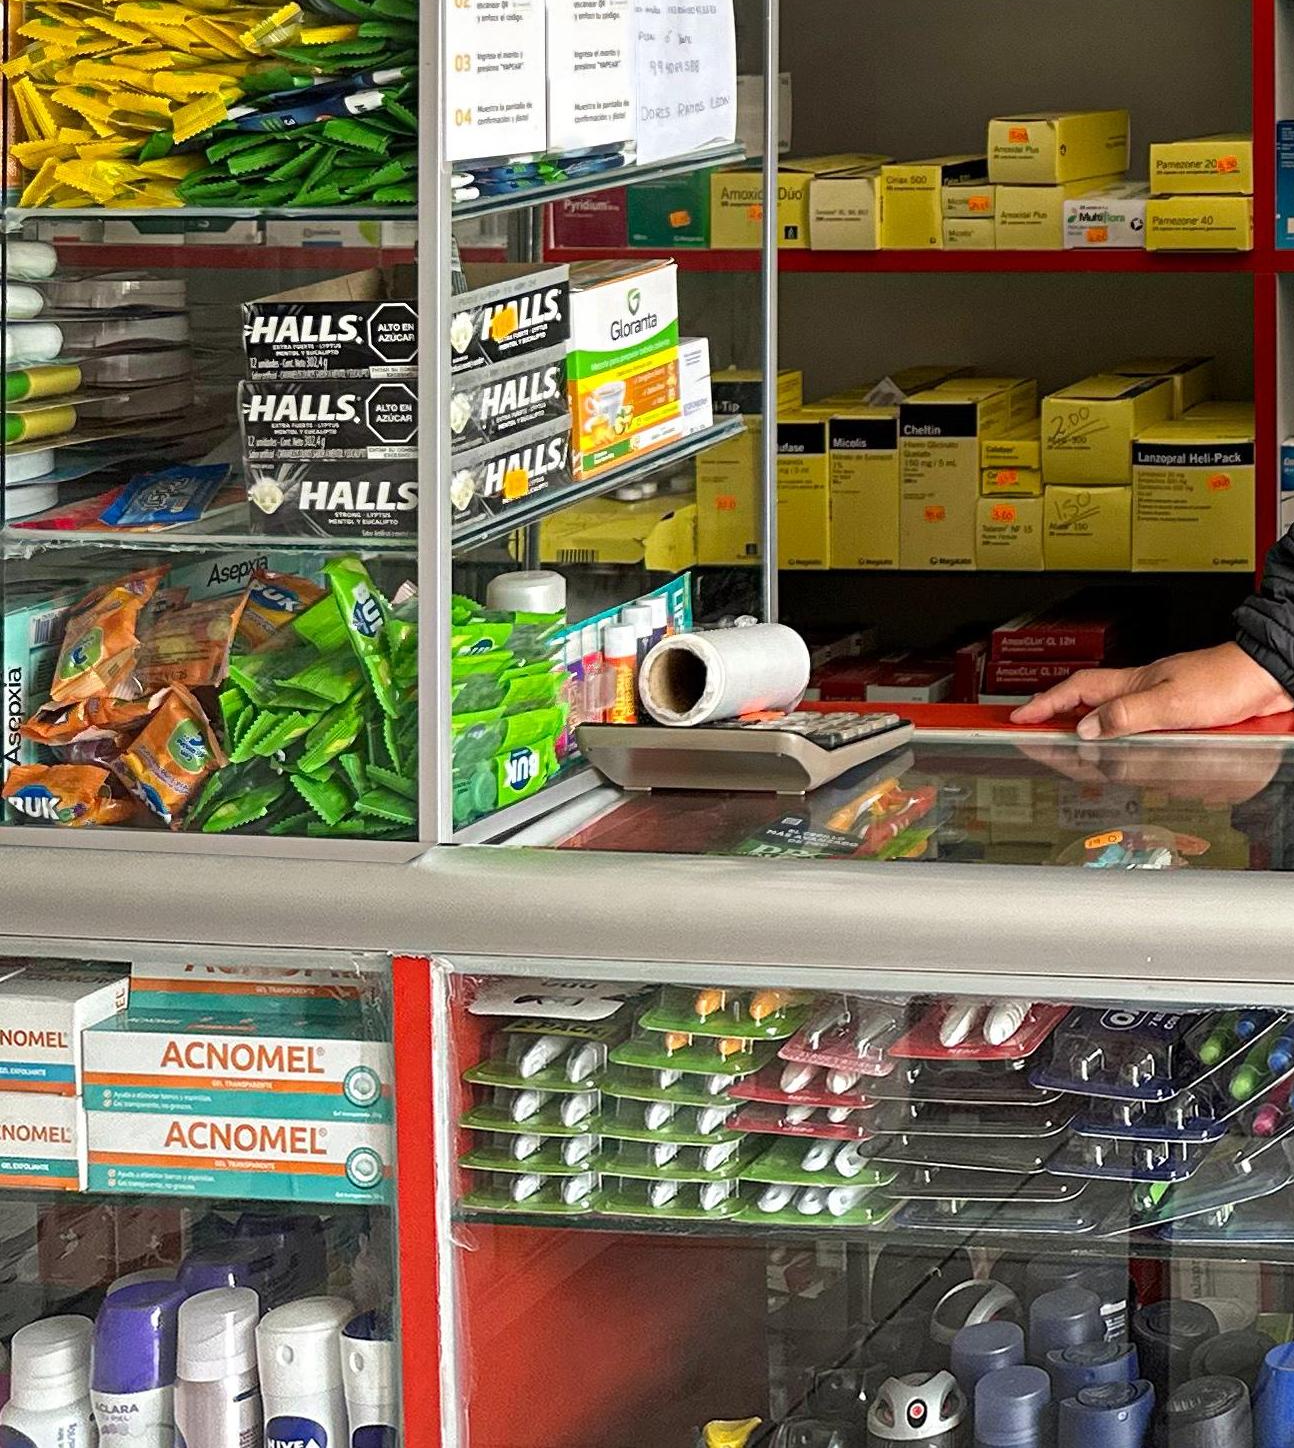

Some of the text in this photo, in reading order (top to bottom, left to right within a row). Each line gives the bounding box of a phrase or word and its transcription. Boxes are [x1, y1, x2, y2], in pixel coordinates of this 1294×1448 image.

[251, 313, 361, 345] HALLS
[377, 323, 400, 333] ALTO
[609, 310, 659, 343] Gloranta
[249, 392, 361, 424] HALLS
[482, 366, 561, 421] HALLS
[1137, 450, 1242, 467] Lanzopral Heli-Pack
[206, 552, 270, 588] Asepxia
[3, 666, 24, 771] Asepxia
[159, 1040, 325, 1074] ACNOMEL
[163, 1120, 326, 1154] ACNOMEL
